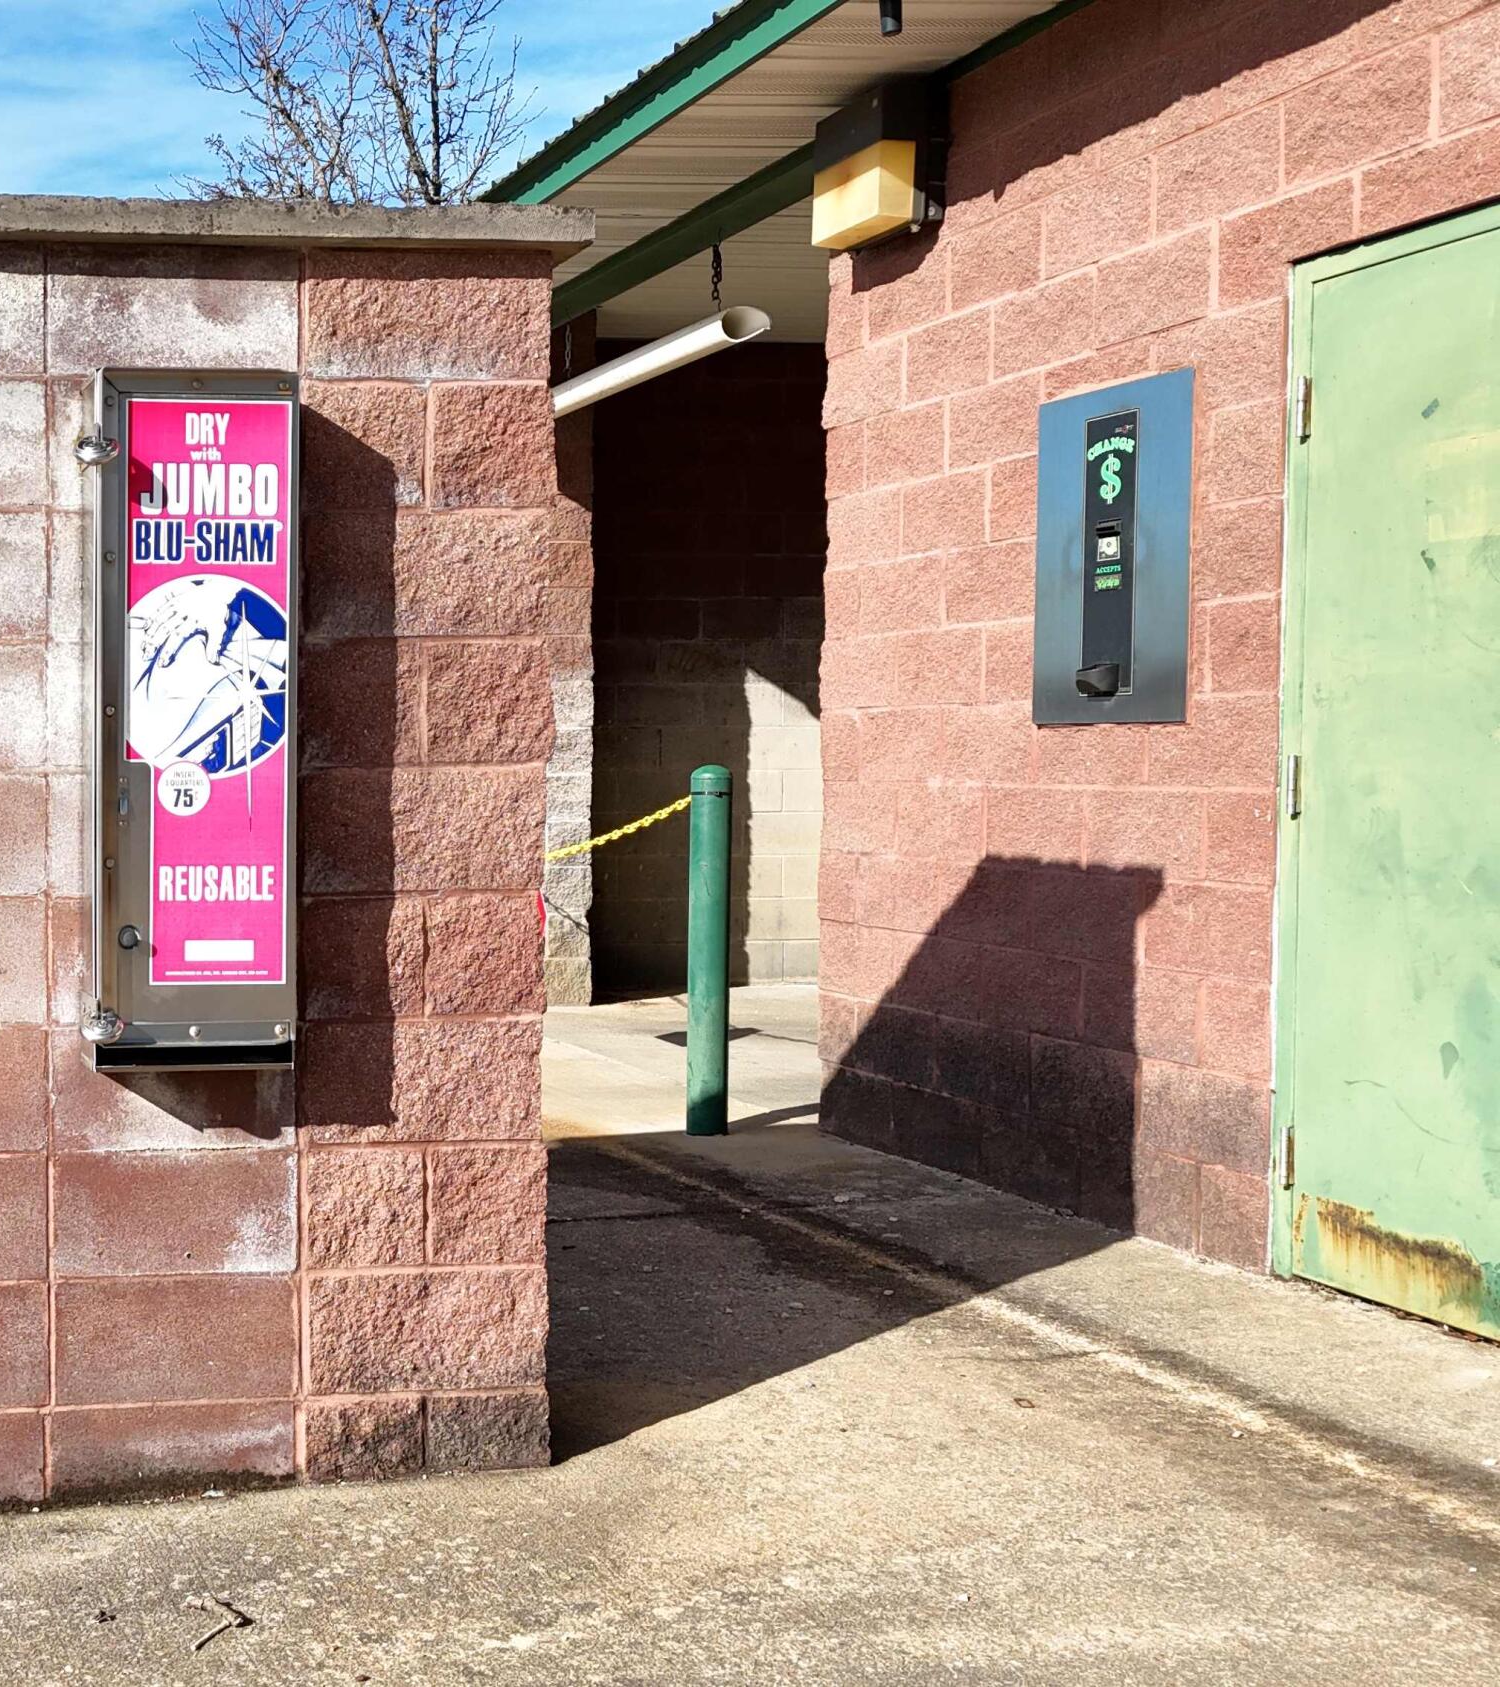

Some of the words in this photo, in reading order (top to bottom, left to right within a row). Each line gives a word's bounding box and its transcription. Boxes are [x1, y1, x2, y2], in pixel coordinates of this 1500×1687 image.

[185, 412, 230, 445] DRY
[190, 447, 221, 461] with
[1087, 436, 1136, 461] CHANGE
[140, 462, 279, 517] JUMBO
[134, 520, 275, 563] BLU-SHAM
[173, 788, 193, 807] 75
[158, 865, 275, 902] REUSABLE
